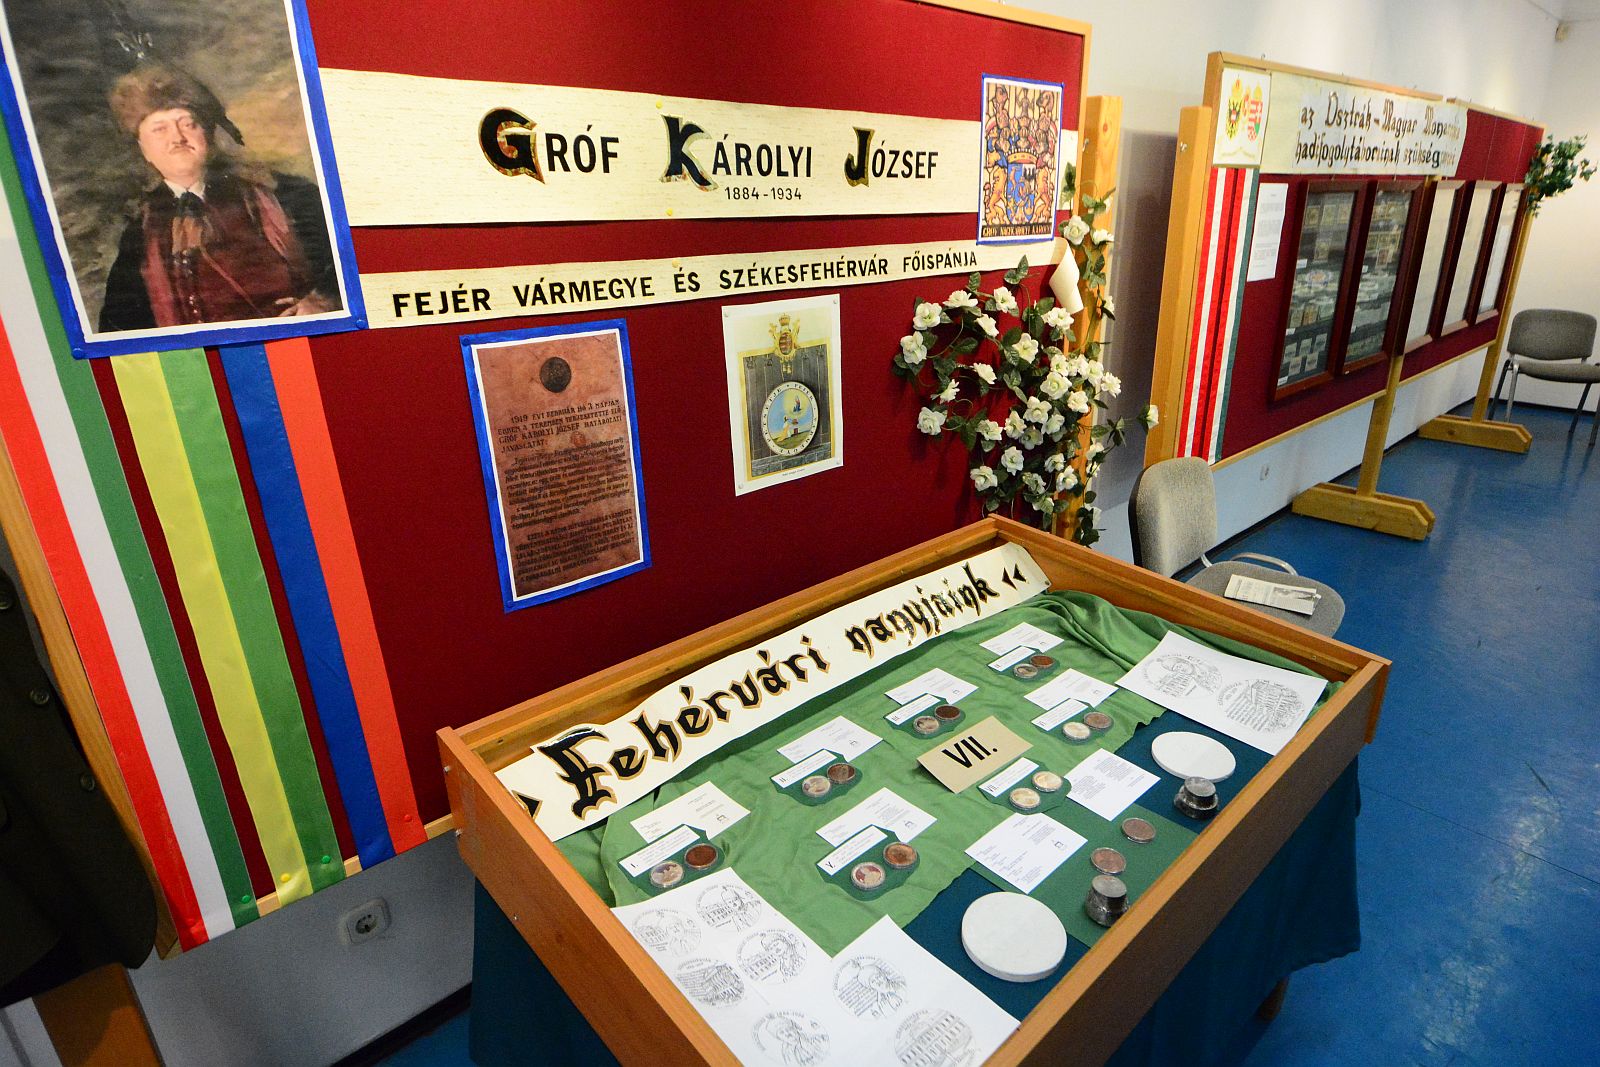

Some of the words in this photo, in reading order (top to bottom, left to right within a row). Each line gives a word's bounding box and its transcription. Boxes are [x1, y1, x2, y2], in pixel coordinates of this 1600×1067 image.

[1300, 106, 1315, 130] az
[478, 106, 620, 185] GRÓF
[660, 113, 812, 192] KÁROLYI
[844, 126, 939, 188] JÓZSEF
[724, 186, 802, 201] 1884-1934
[392, 283, 492, 318] FEJÉR
[512, 276, 655, 307] VÁRMEGYE
[673, 266, 701, 293] ÉS
[719, 254, 889, 290] SZÉKESFEHÉRVÁR
[902, 248, 978, 273] FŐISPÁNJA
[536, 633, 832, 821] Fehérvári
[940, 735, 998, 769] VII.
